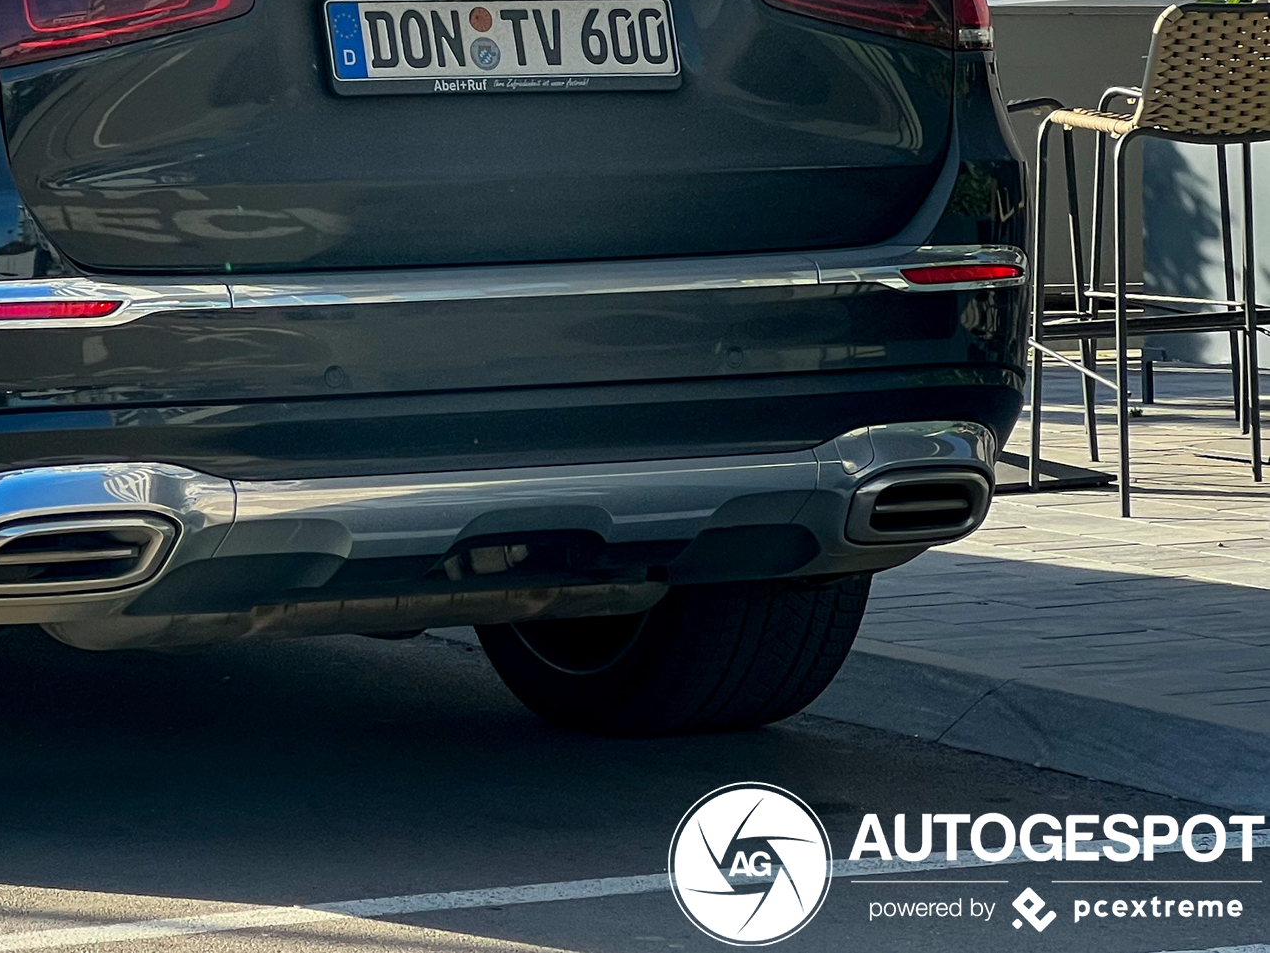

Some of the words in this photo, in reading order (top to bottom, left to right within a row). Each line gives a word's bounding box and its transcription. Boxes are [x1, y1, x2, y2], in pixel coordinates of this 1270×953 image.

[364, 9, 467, 69] DON
[500, 8, 562, 66] TV
[580, 8, 669, 65] 600
[344, 49, 356, 66] D
[434, 78, 487, 92] Abel+Ruf
